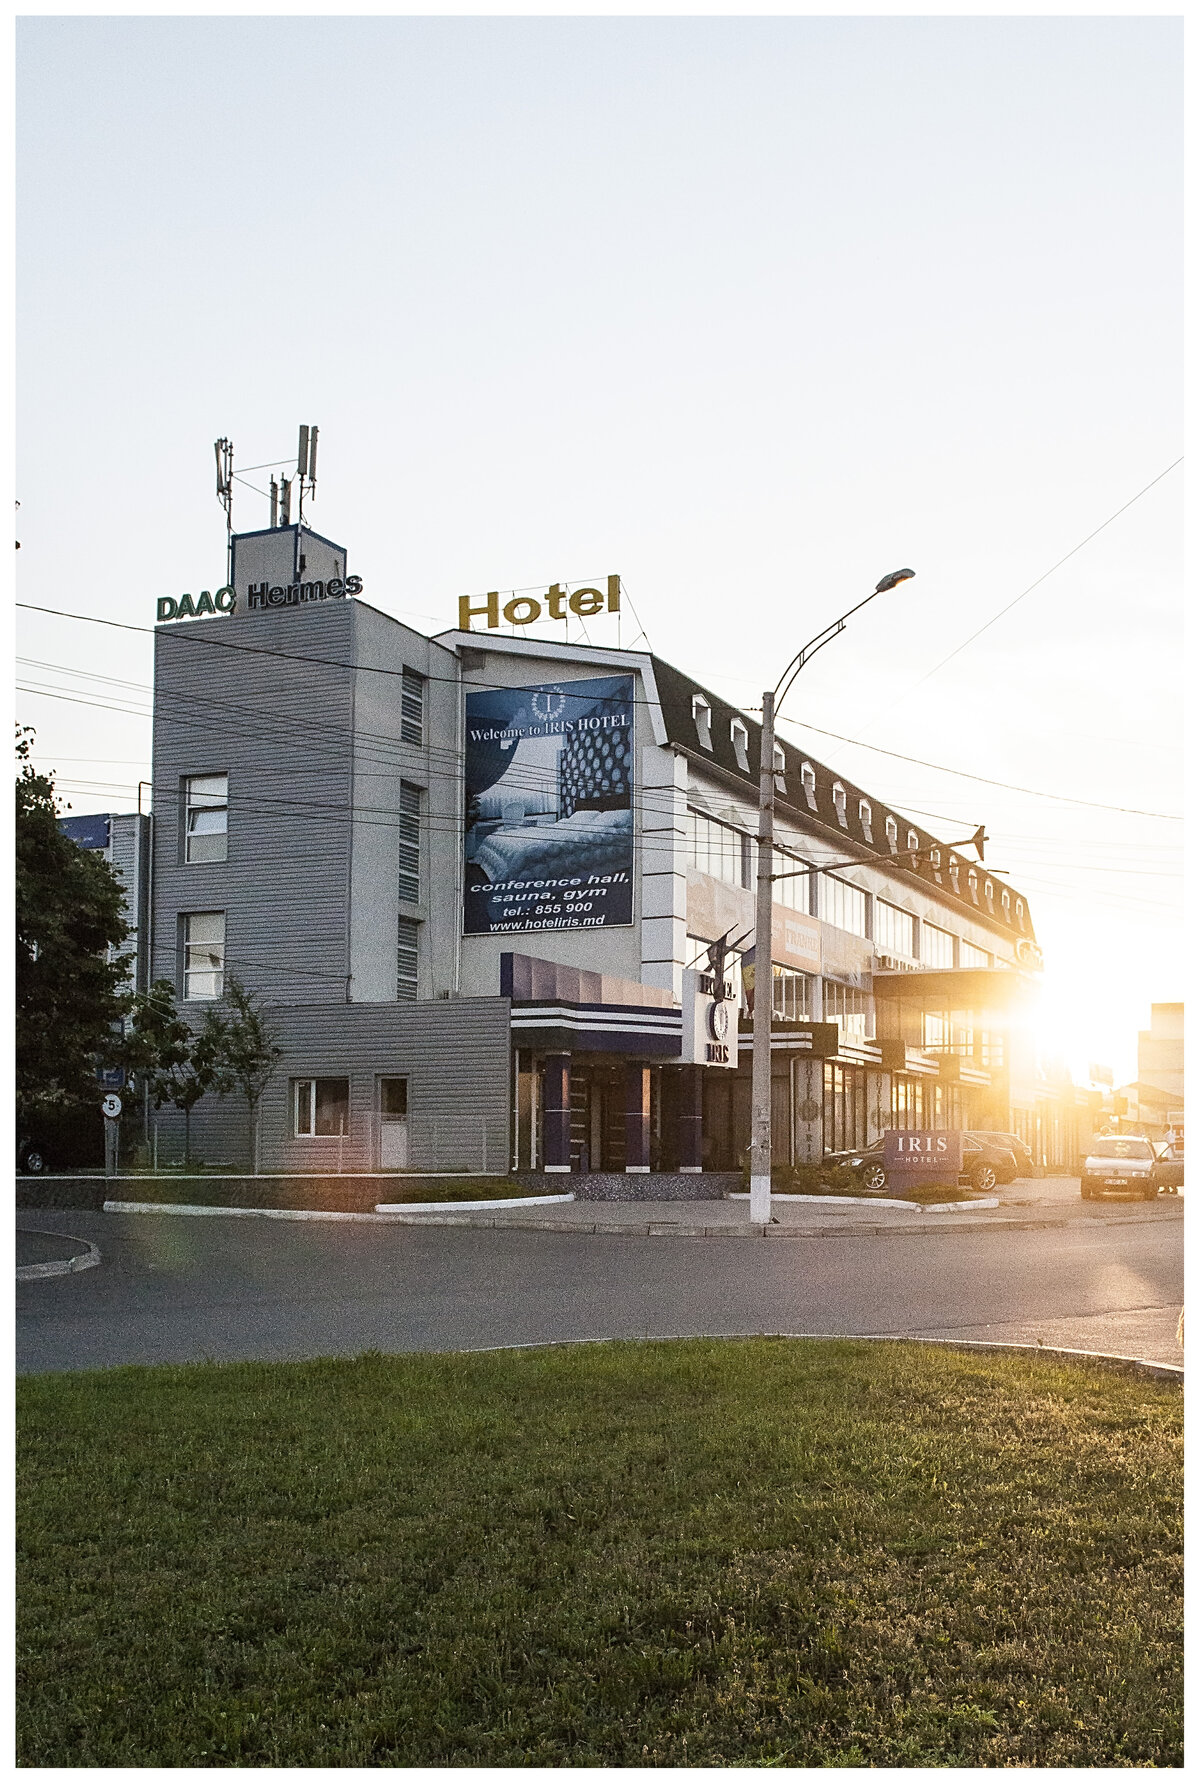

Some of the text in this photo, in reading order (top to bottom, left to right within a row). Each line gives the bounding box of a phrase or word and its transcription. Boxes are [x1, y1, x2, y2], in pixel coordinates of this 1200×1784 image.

[157, 575, 363, 622] DAAC Hermes
[458, 574, 621, 631] Hotel
[471, 714, 631, 741] Welcome to IRIS HOTEL
[471, 873, 630, 893] conference hall,
[492, 888, 607, 903] sauna, gym
[503, 902, 593, 917] tel.: 855 900
[490, 915, 606, 931] www.hoteliris.md
[706, 1043, 730, 1063] IRIS
[108, 1100, 116, 1111] 5
[897, 1136, 948, 1152] IRIS
